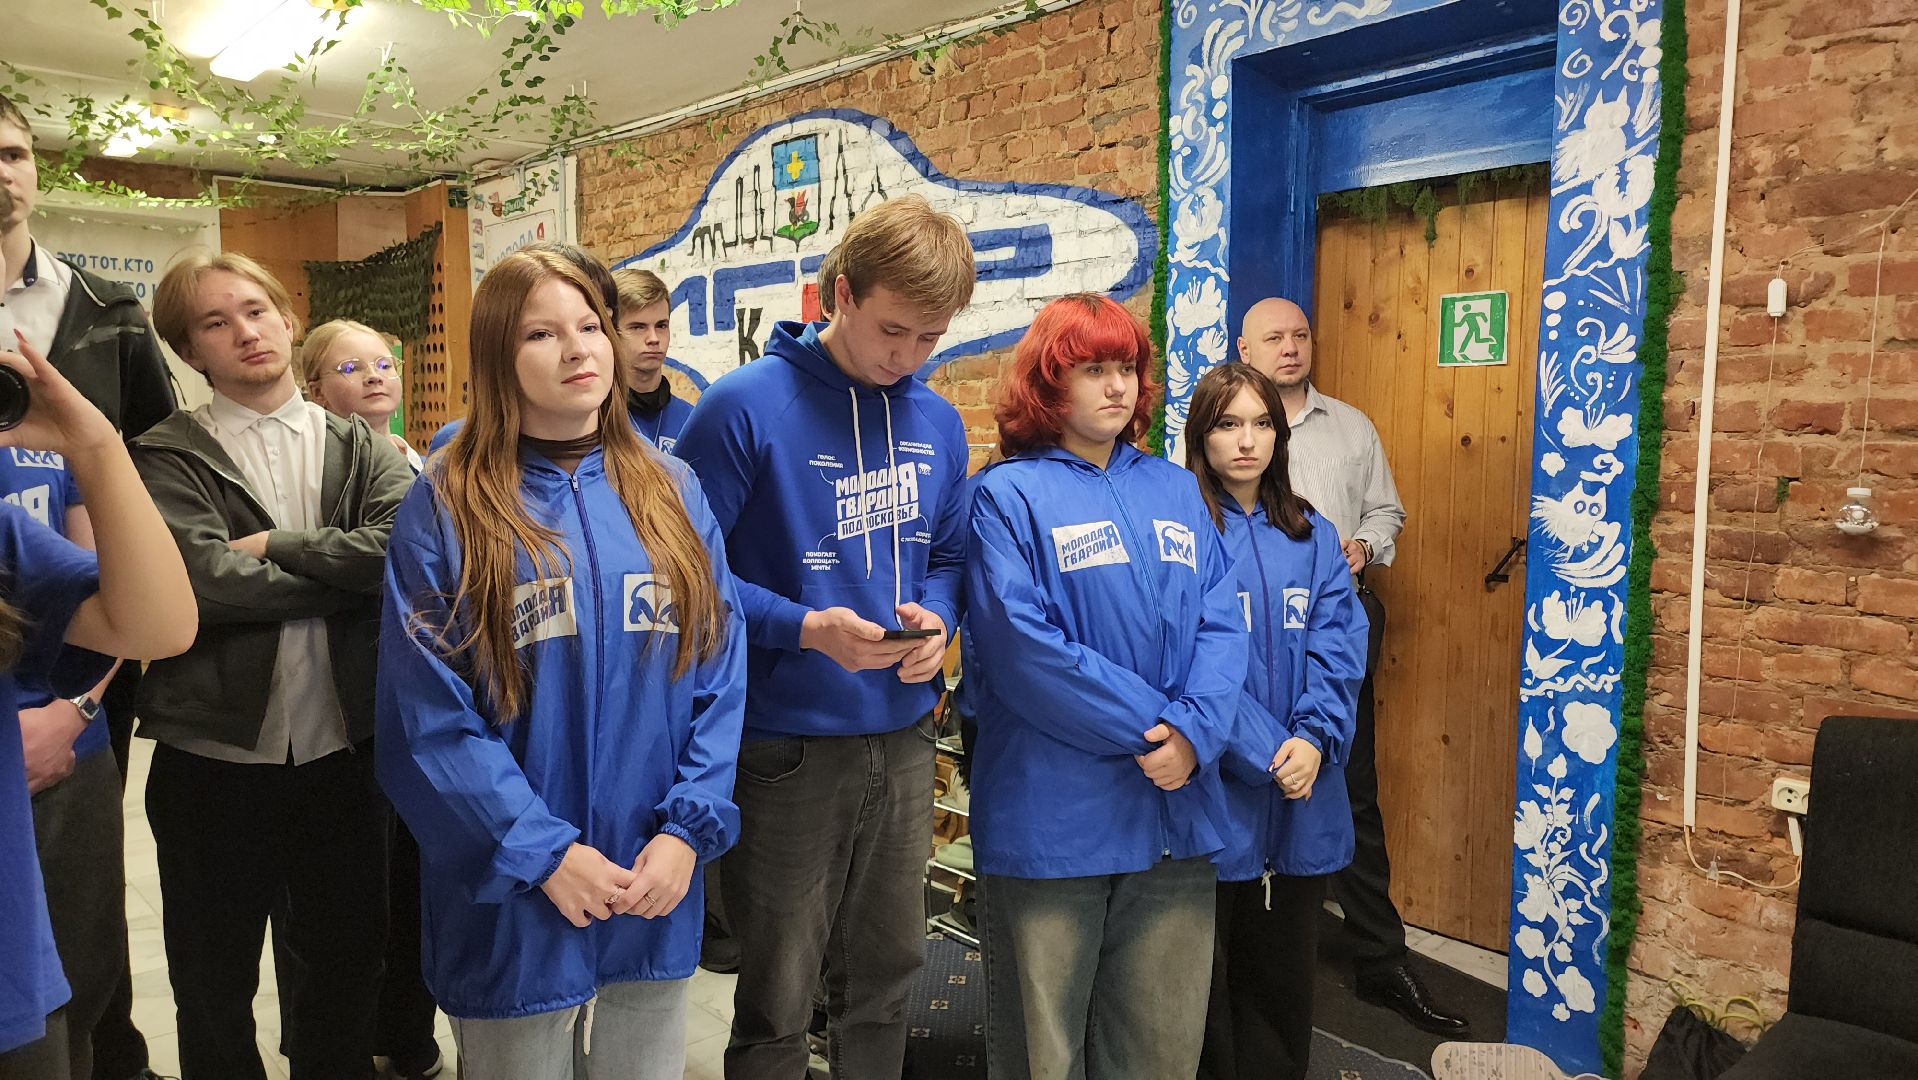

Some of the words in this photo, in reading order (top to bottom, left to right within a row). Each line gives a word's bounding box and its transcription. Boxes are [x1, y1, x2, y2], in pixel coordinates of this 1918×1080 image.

[124, 257, 154, 274] КТО
[1061, 524, 1121, 555] МОЛОДАЯ
[511, 584, 567, 623] ЛОДАЯ
